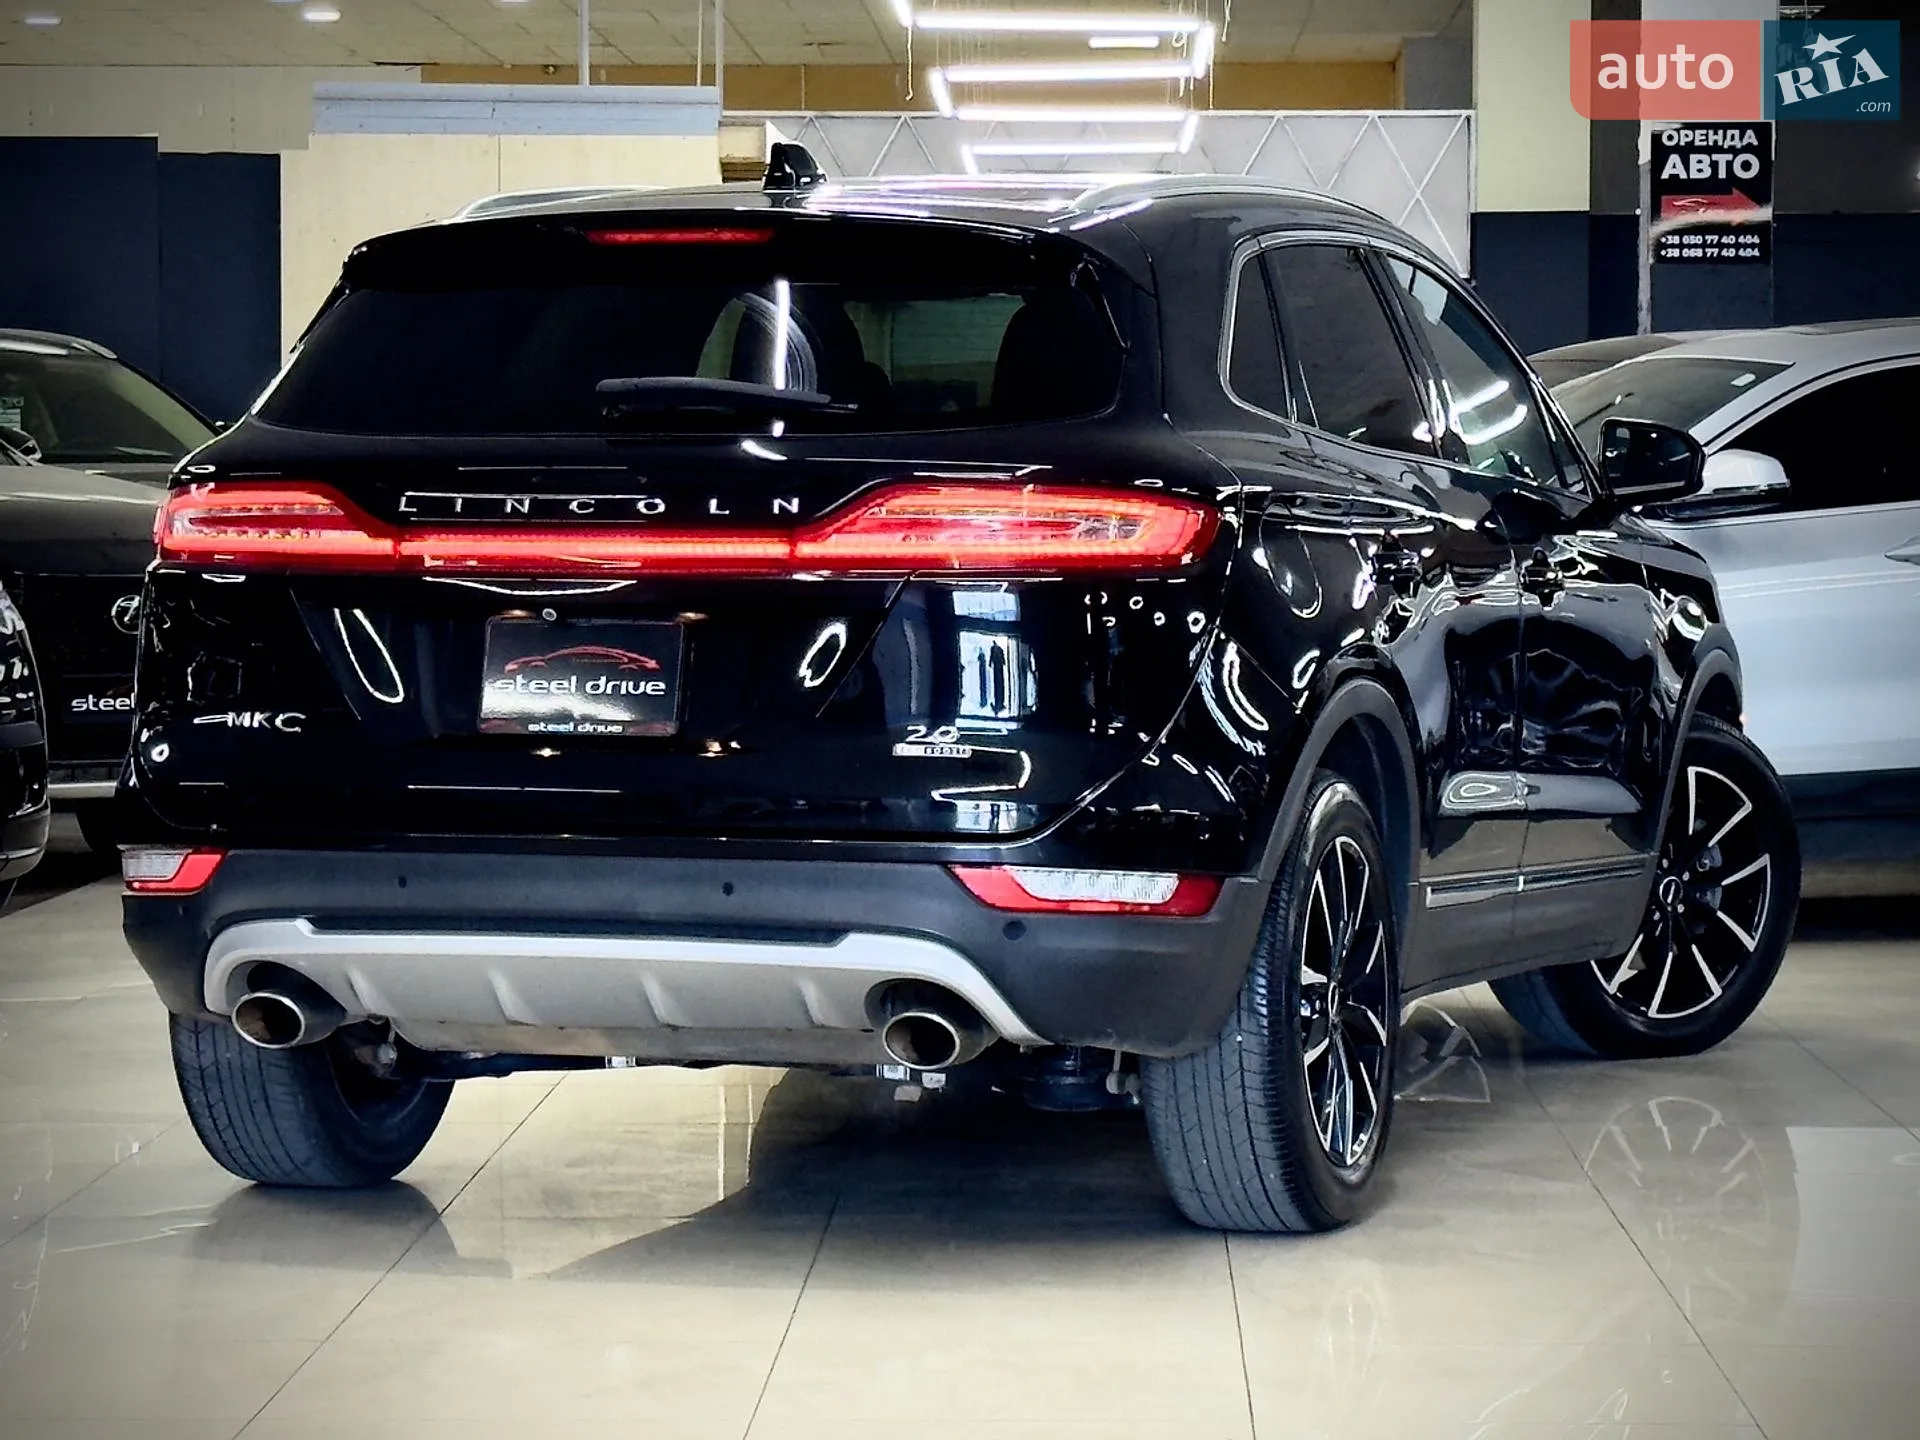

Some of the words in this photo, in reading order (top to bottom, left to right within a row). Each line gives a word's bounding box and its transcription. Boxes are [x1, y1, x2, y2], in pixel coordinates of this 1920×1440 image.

[1661, 129, 1759, 149] ОРЕНДА
[1660, 153, 1760, 179] АВТО
[1660, 235, 1680, 244] +38
[1705, 235, 1719, 244] 77
[1720, 235, 1736, 244] 40
[1738, 235, 1760, 244] 404
[1705, 248, 1719, 257] 77
[1720, 248, 1736, 257] 40
[1738, 248, 1760, 257] 404
[398, 496, 800, 515] LINCOLN
[496, 674, 577, 694] steel
[585, 676, 667, 695] drive
[71, 693, 135, 711] steel
[227, 712, 306, 732] MKC
[528, 722, 574, 733] steel
[577, 722, 624, 733] drive
